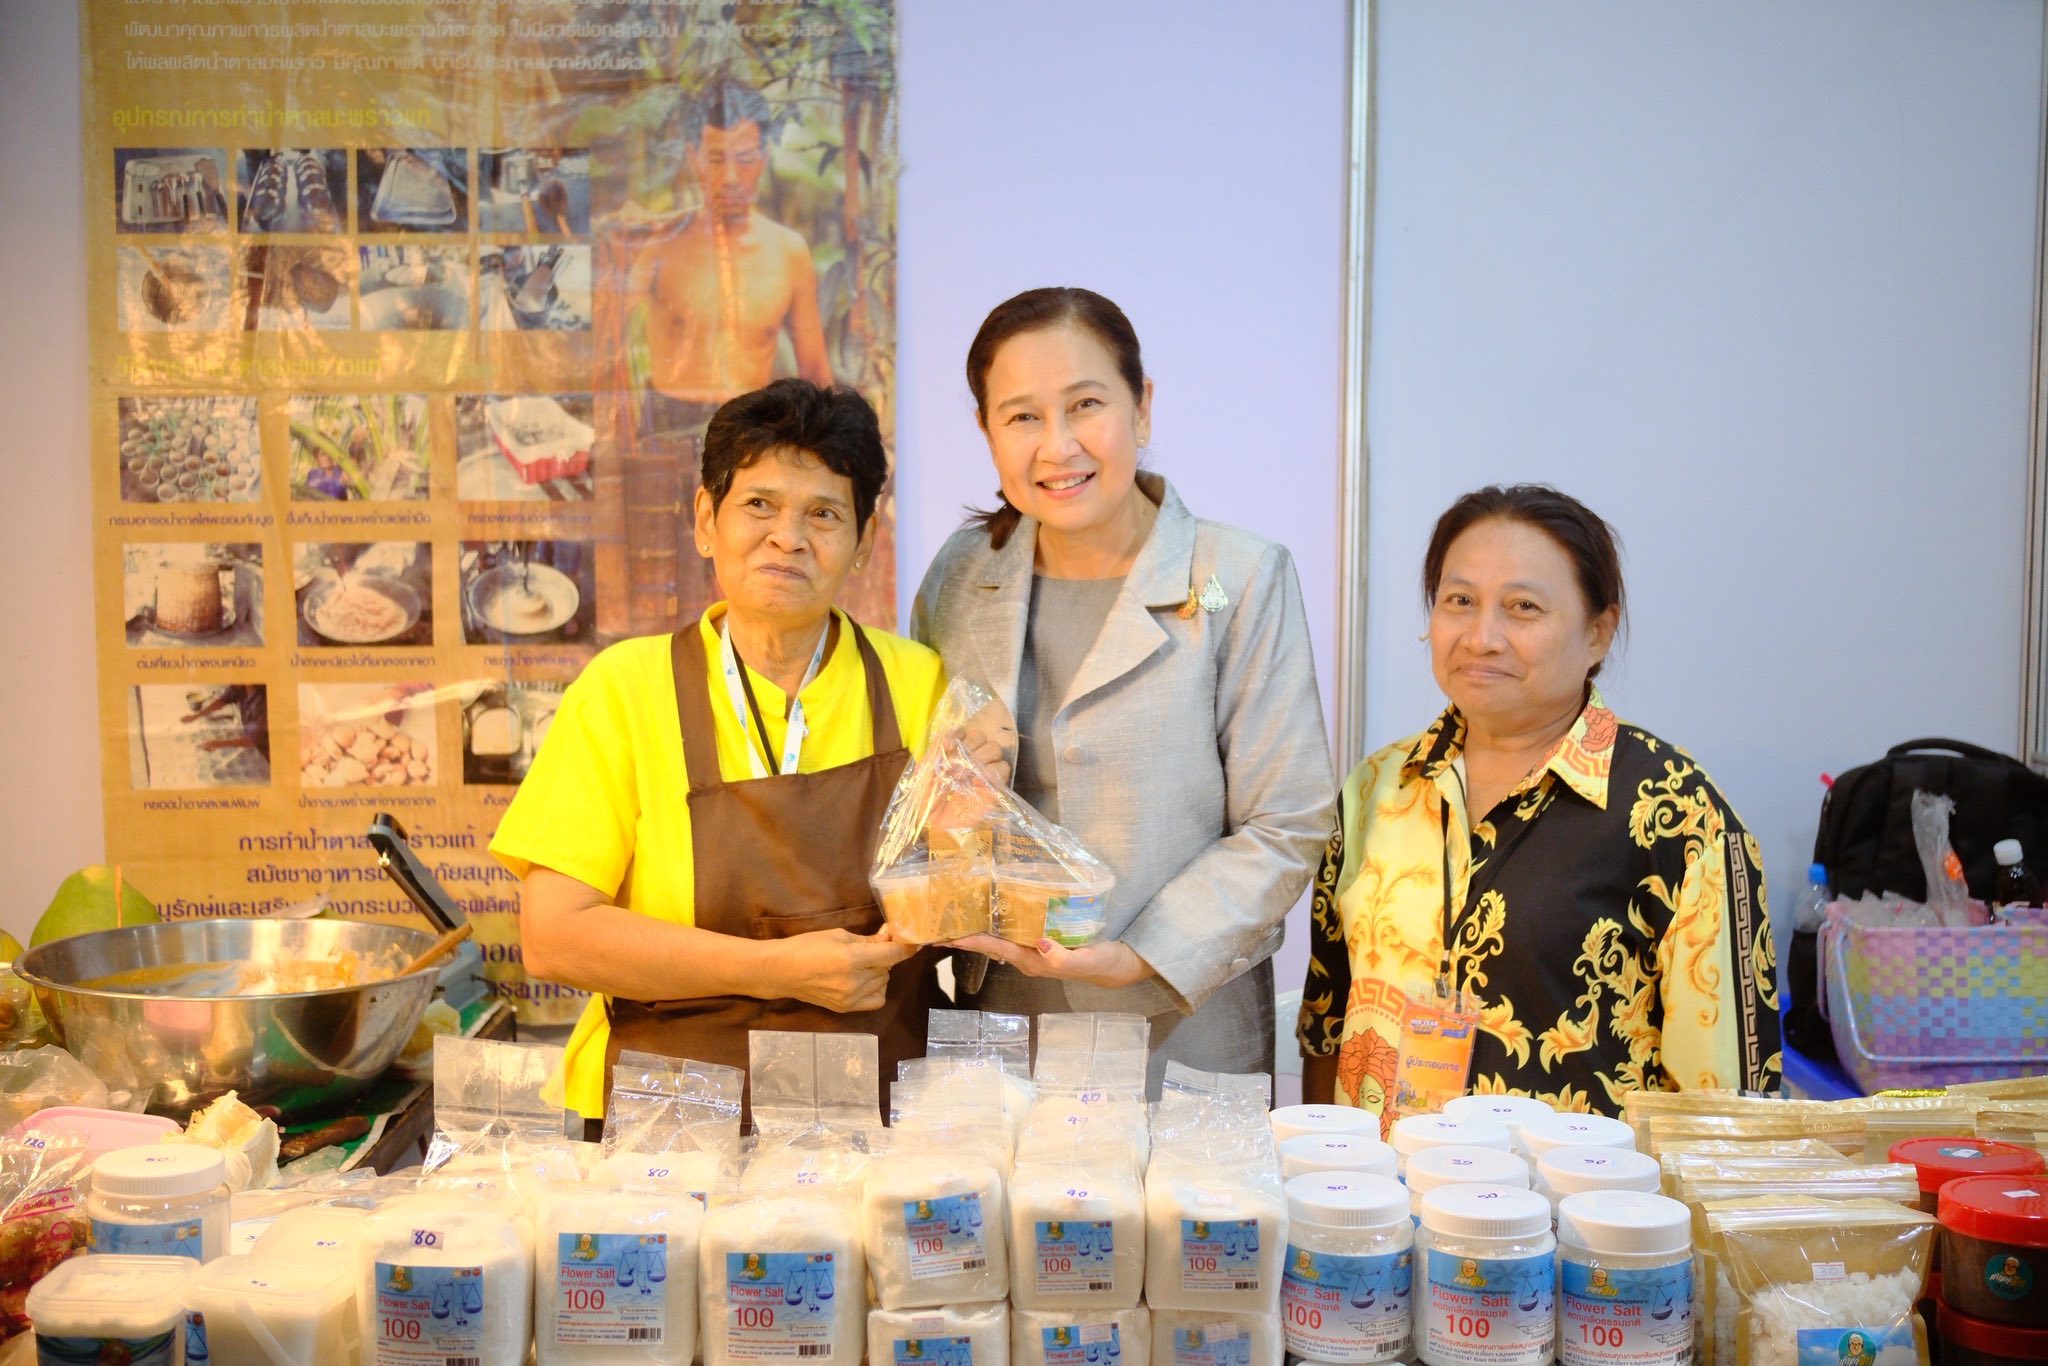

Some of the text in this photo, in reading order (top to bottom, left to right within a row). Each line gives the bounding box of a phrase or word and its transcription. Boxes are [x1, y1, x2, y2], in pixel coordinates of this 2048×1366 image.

[647, 1167, 670, 1178] 80
[414, 1229, 437, 1246] 80
[561, 1266, 616, 1280] Flower Salt
[730, 1284, 784, 1298] Flower Salt
[1282, 1280, 1309, 1295] ower
[1314, 1287, 1342, 1302] Salt
[1432, 1285, 1510, 1307] Flower Salt
[378, 1295, 431, 1311] Flower Salt
[1432, 1300, 1509, 1318] ดอกเกลือธรรมชาติ
[1566, 1295, 1642, 1317] Flower Salt
[1567, 1310, 1642, 1327] ดอกเกลือธรรมชาติ
